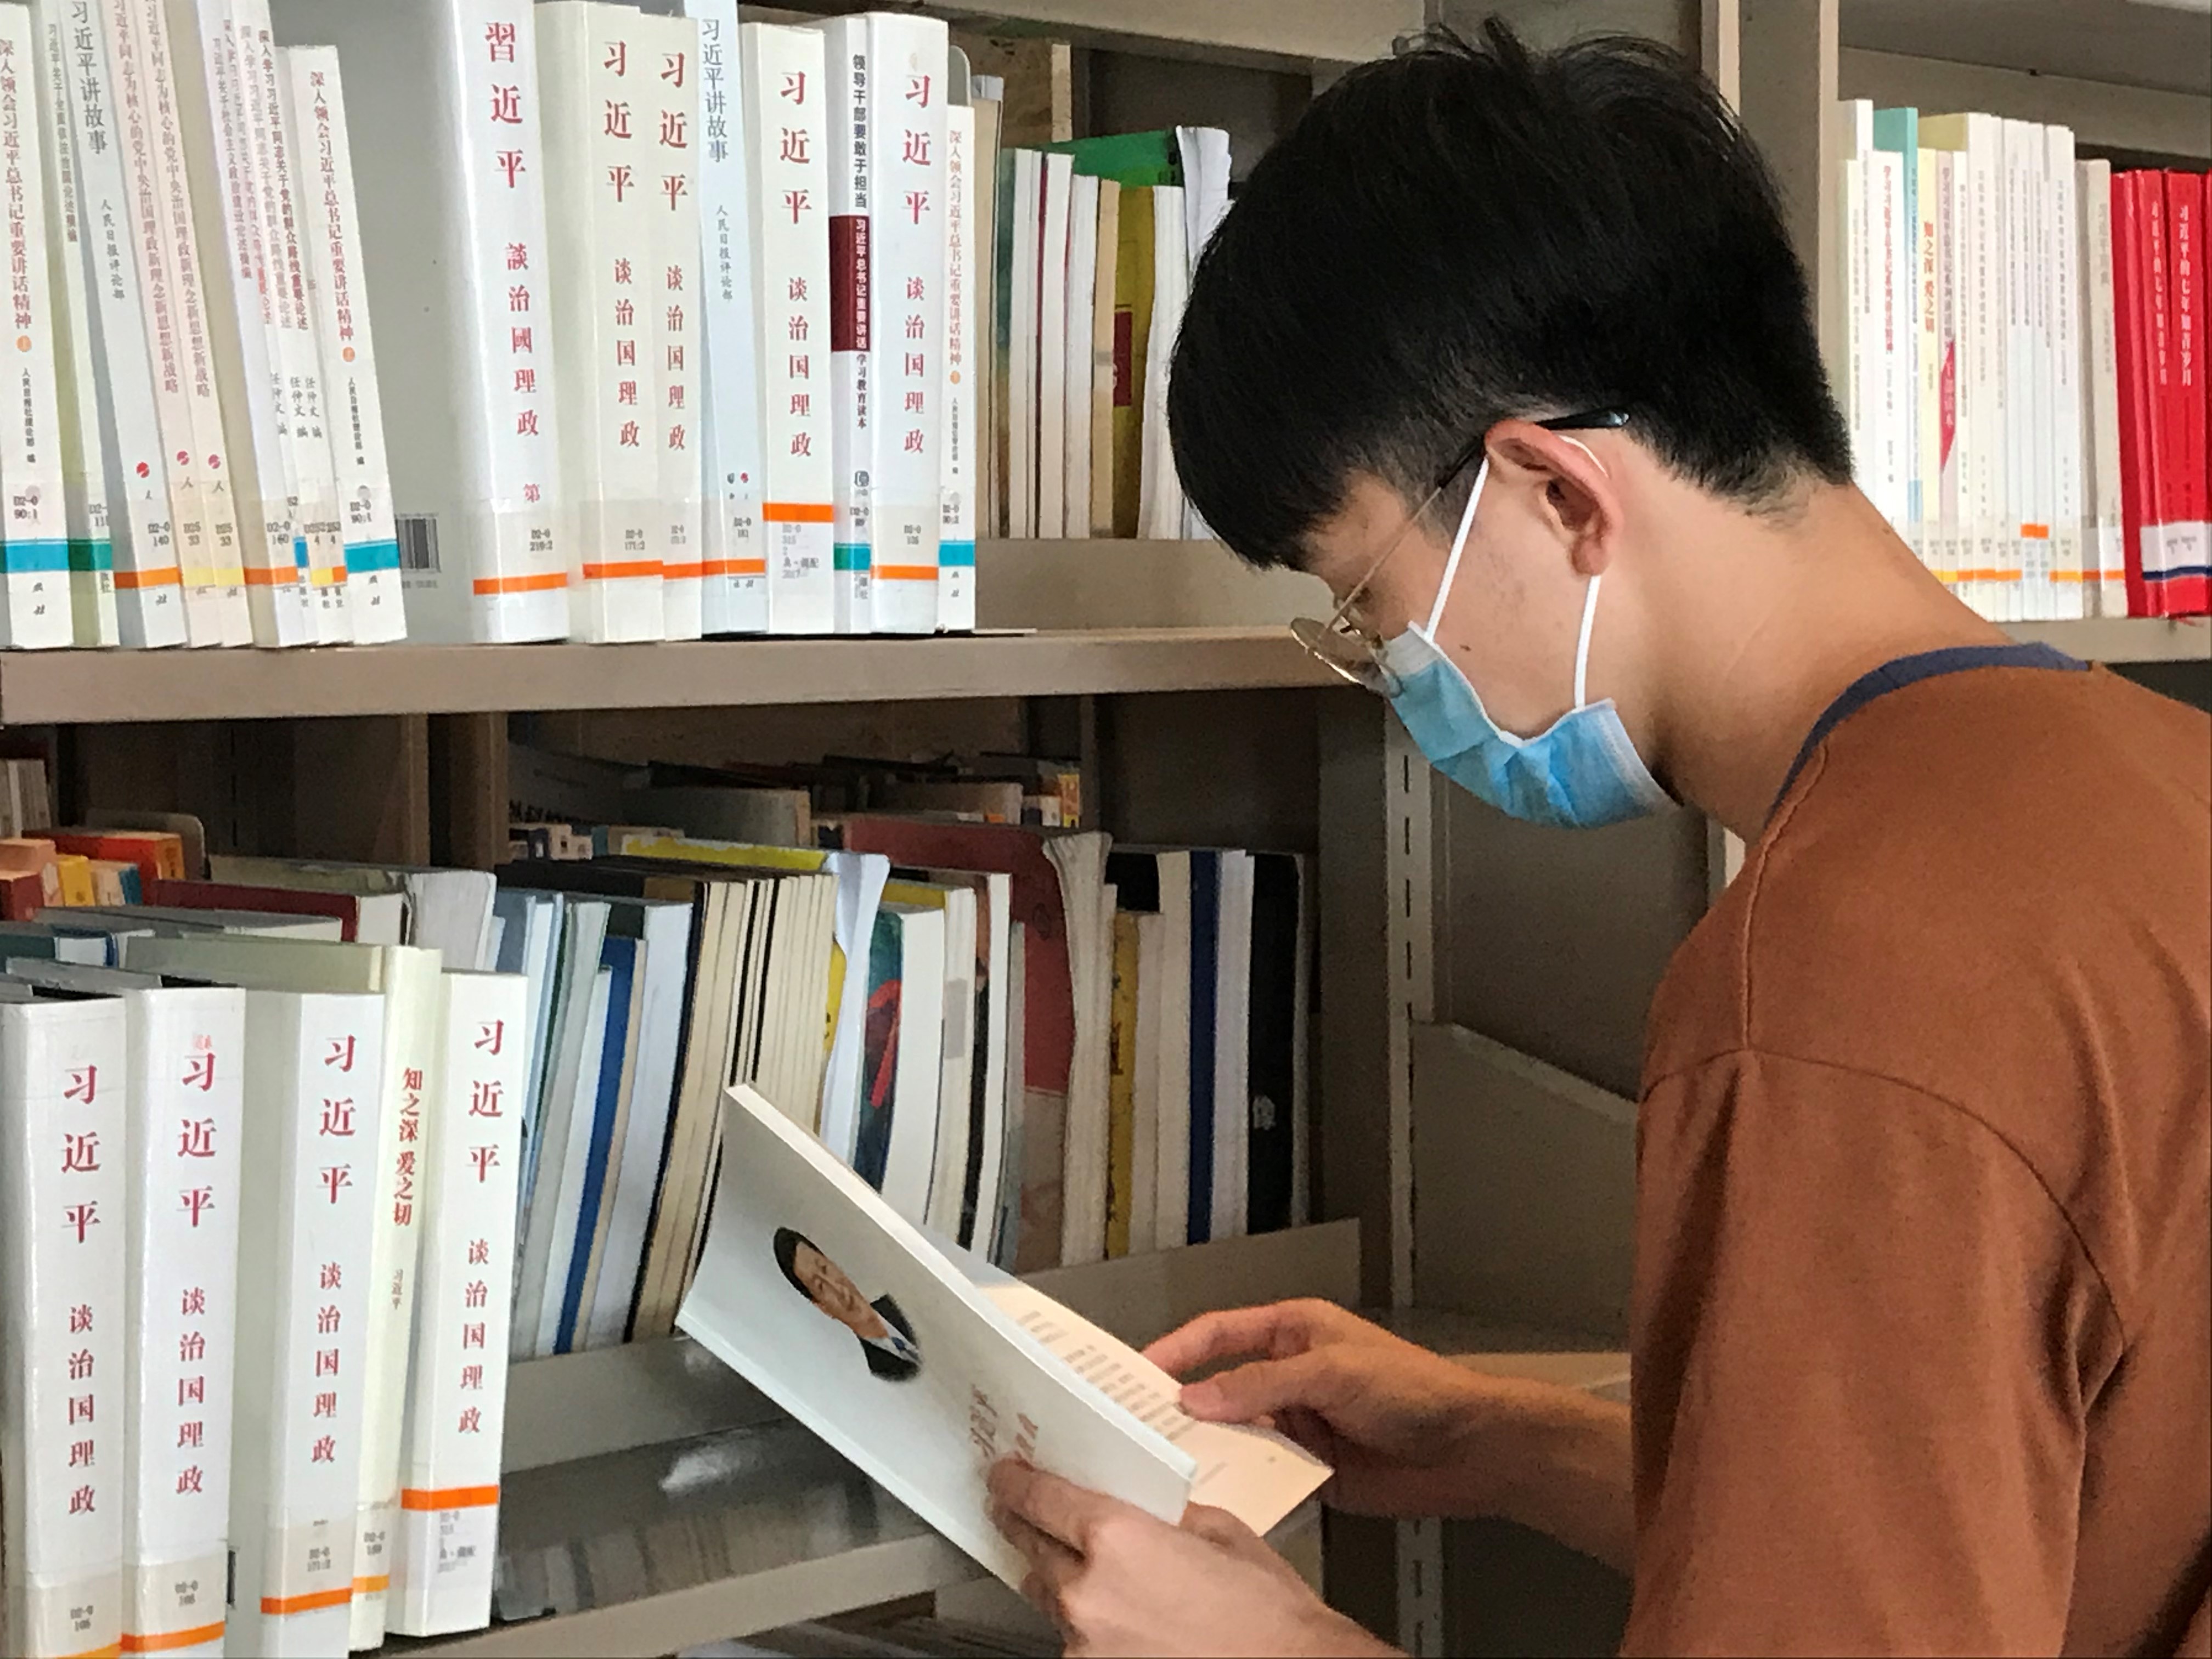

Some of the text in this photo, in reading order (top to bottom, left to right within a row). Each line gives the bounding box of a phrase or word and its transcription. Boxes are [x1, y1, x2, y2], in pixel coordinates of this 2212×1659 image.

[71, 1, 108, 154] 习近平讲故事
[702, 18, 729, 163] 习近平讲故事
[853, 53, 867, 209] 领导干部要敢于担当
[485, 21, 540, 503] 習近平 談治國理政 第
[603, 40, 640, 448] 习近平 谈治国理政
[659, 52, 689, 451] 习近平 谈治国理政
[716, 204, 733, 303] 人民日报评论部
[780, 71, 812, 457] 习近平 谈治国理政
[855, 219, 867, 349] 习近平总书记重要讲话
[902, 74, 932, 454] 习近平 谈治国理政
[856, 353, 867, 429] 学习教育读本
[177, 1052, 218, 1228] 习近平
[393, 1067, 424, 1226] 知之深 爱之切
[457, 1019, 504, 1434] 习近平 谈治国理政
[61, 1064, 101, 1515] 习近平 谈治国理政
[310, 1034, 357, 1464] 习近平 谈治国理政
[175, 1286, 206, 1495] 谈治国理政
